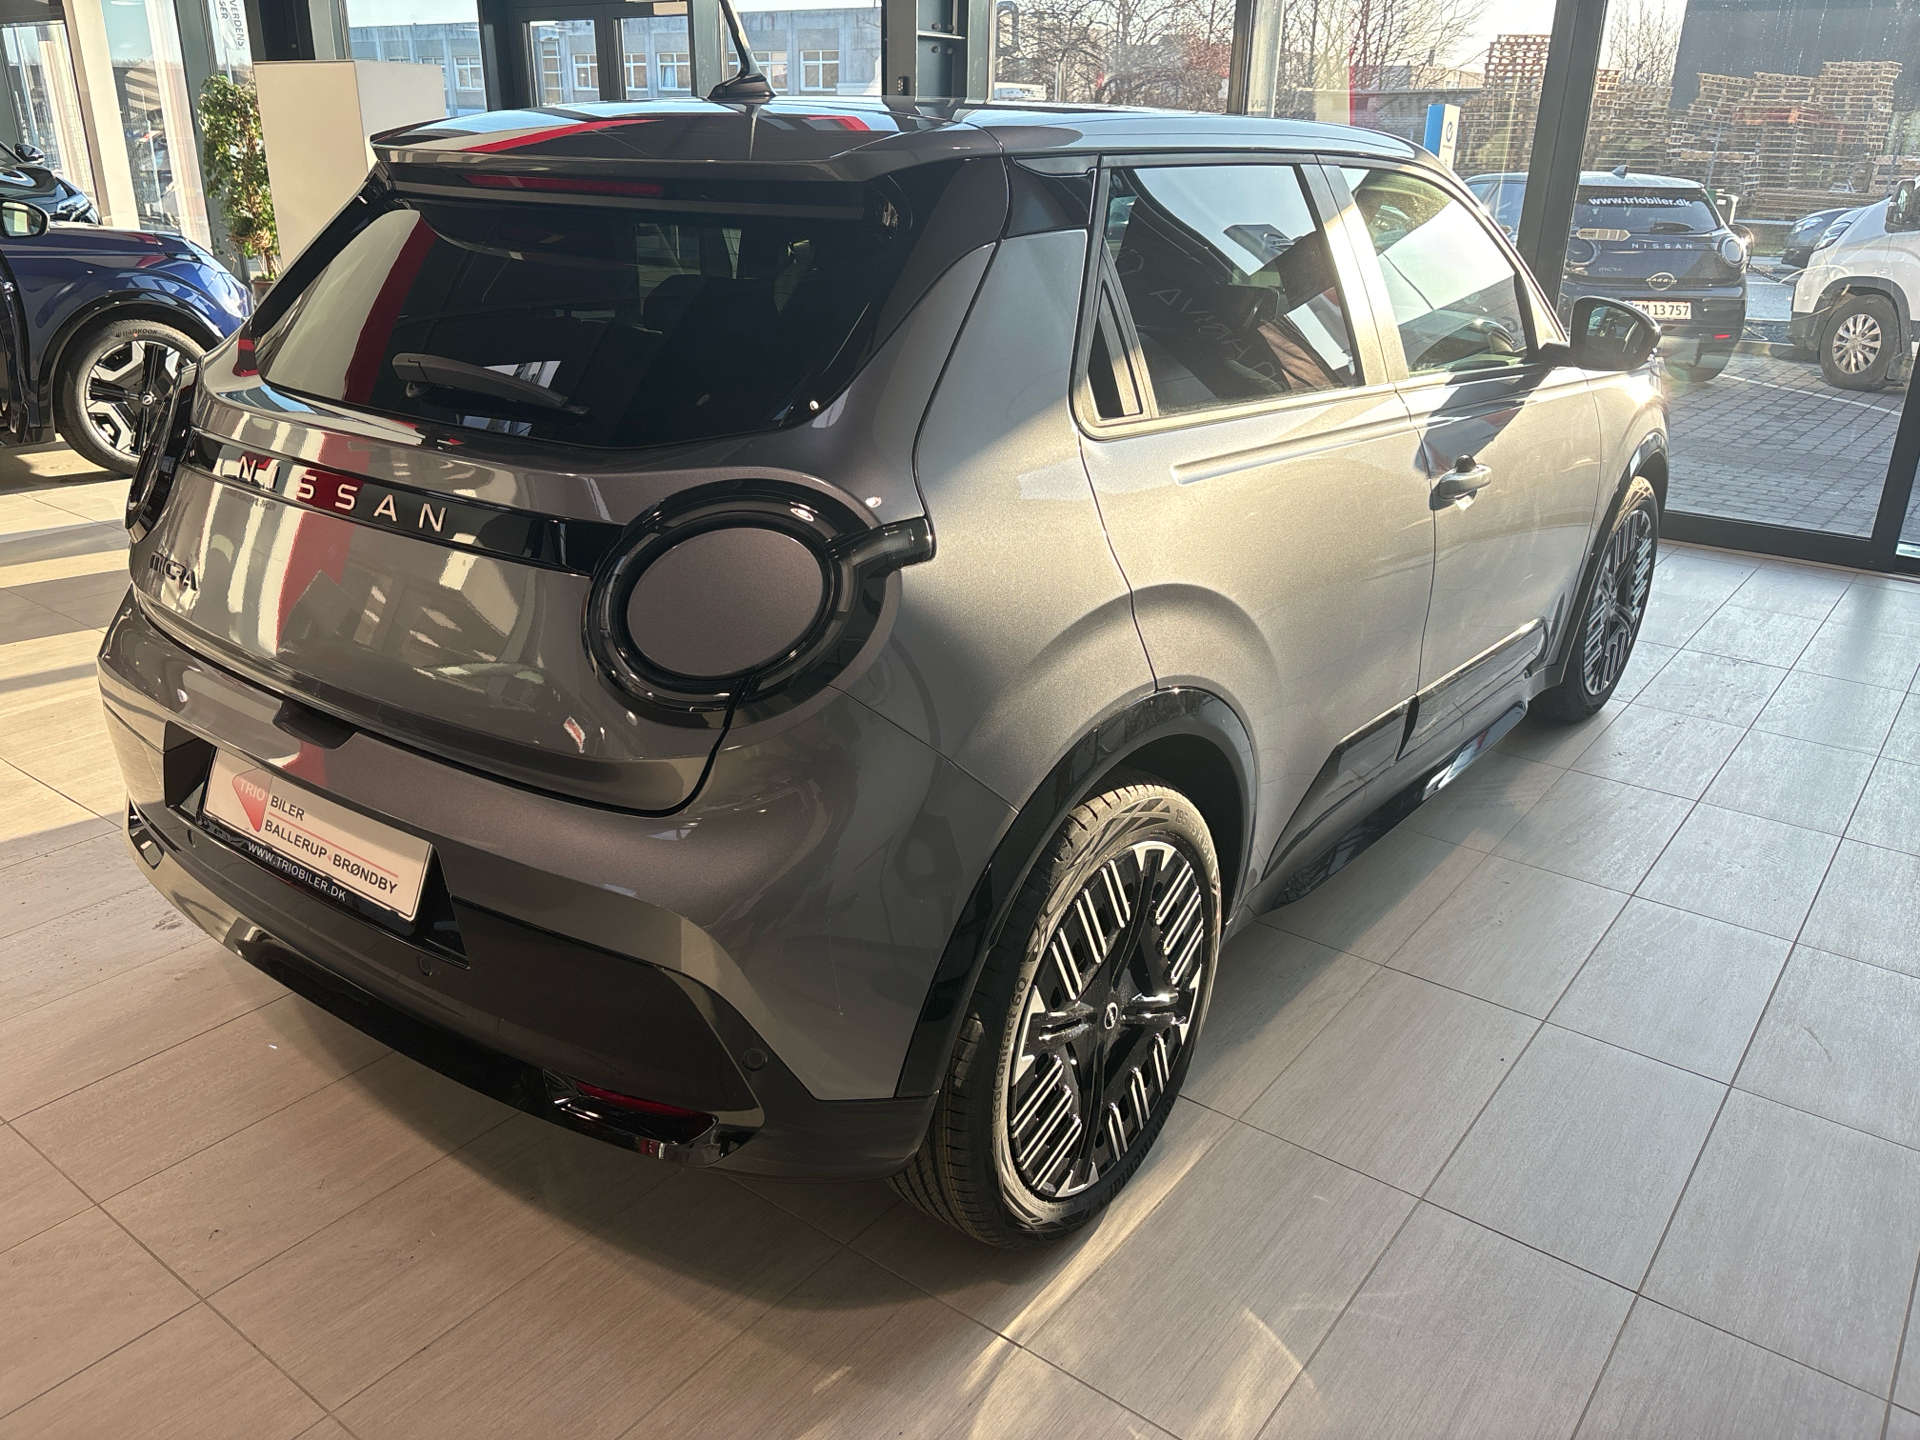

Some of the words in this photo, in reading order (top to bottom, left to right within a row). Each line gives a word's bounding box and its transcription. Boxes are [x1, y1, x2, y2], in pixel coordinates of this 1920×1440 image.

[1589, 197, 1693, 207] www.triobiler.dk
[1653, 304, 1666, 316] 13
[1668, 305, 1689, 316] 757
[238, 455, 448, 534] NISSAN
[149, 553, 198, 592] MICRA
[239, 777, 267, 802] TRIO
[270, 794, 306, 822] BILER
[247, 841, 348, 903] WWW.TRIOBILER.DK
[264, 819, 329, 860] BALLERUP
[332, 852, 399, 896] BRØNDBY
